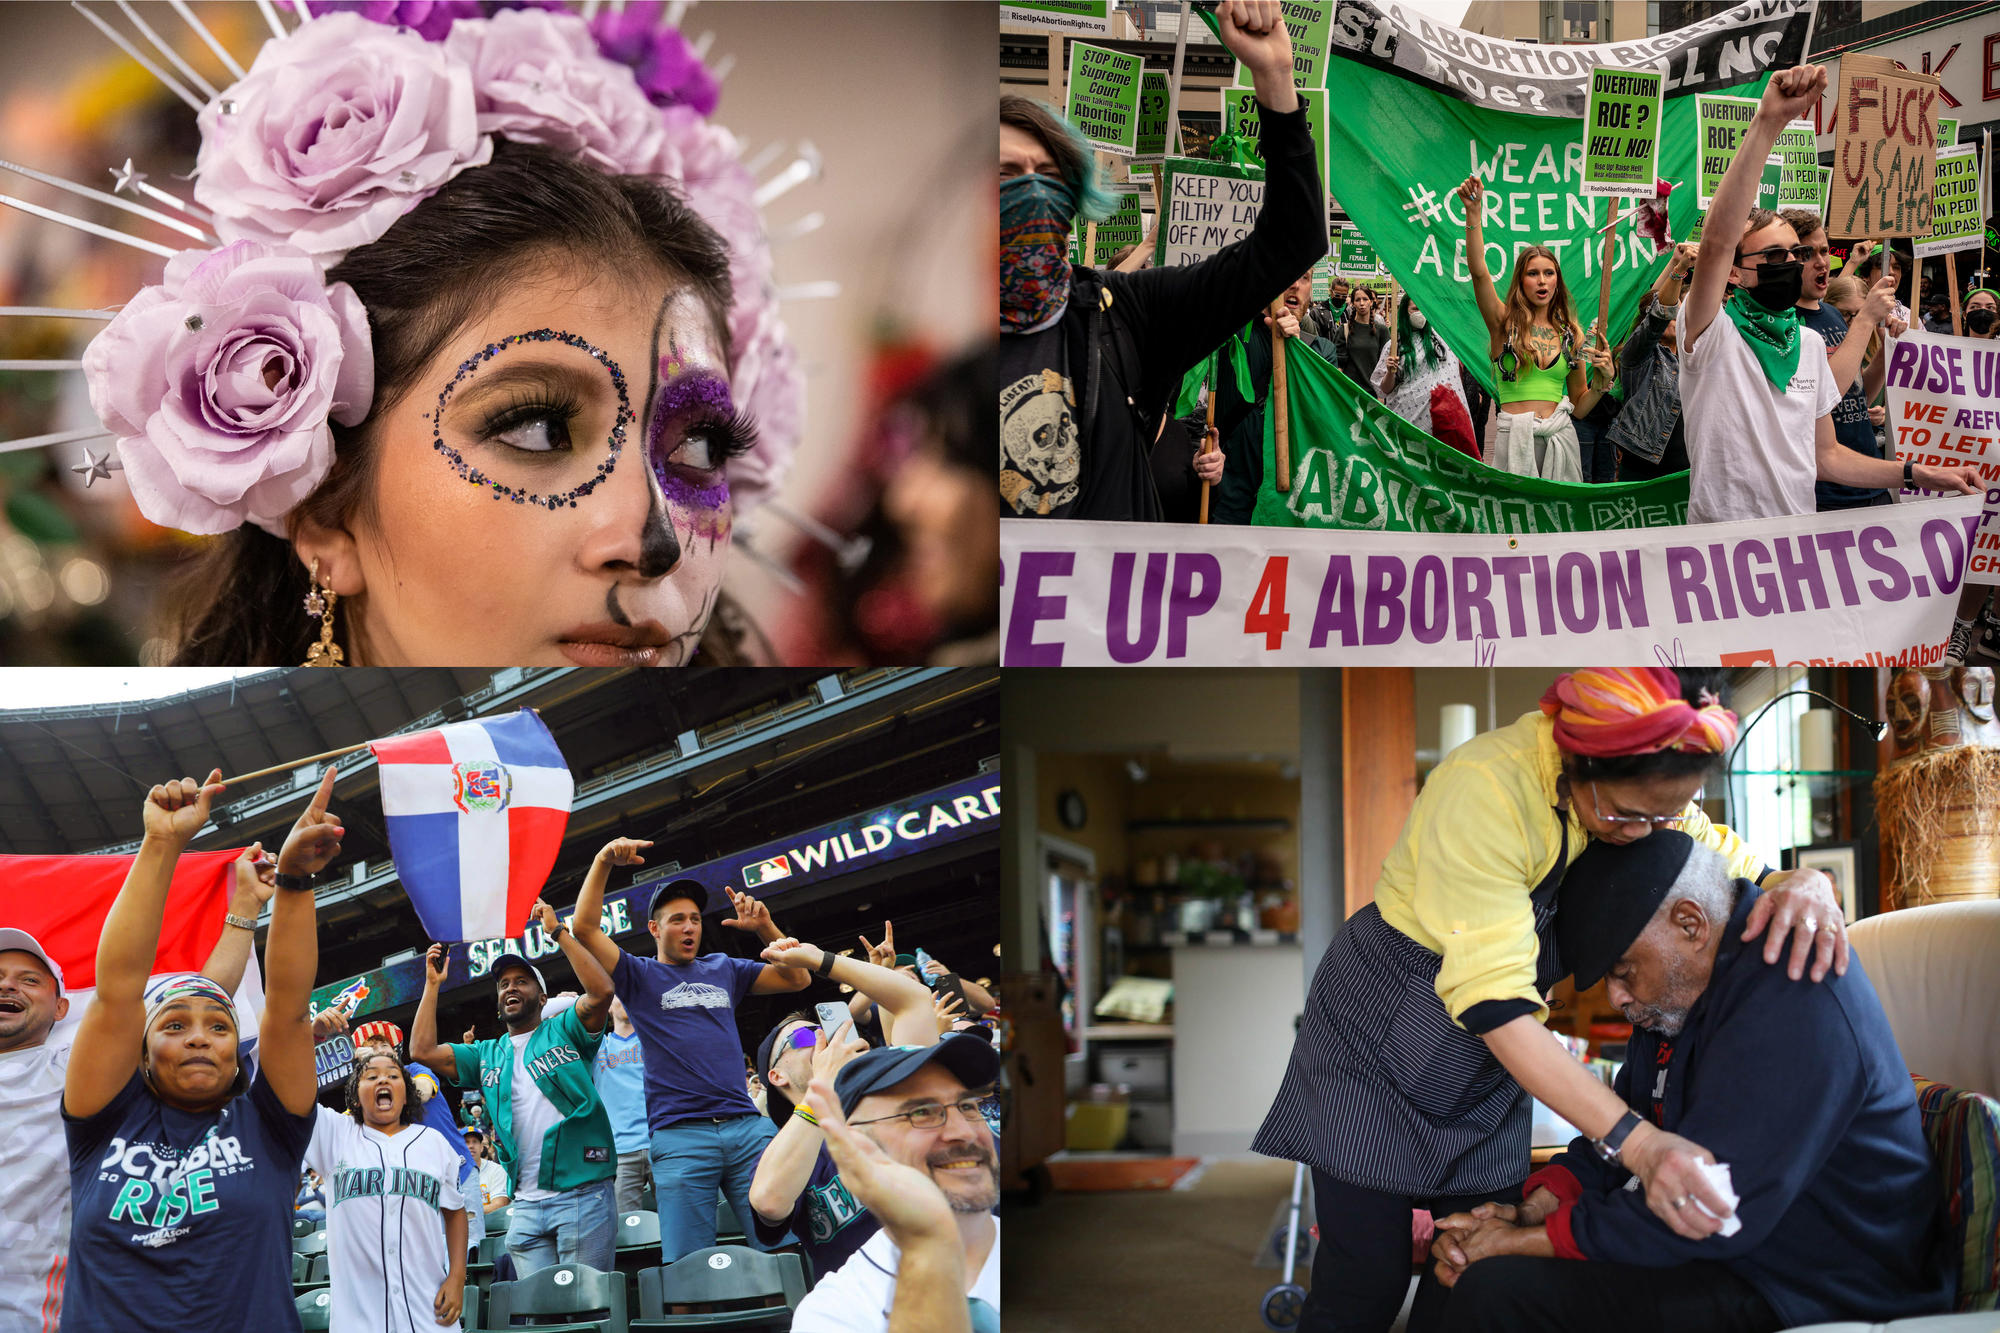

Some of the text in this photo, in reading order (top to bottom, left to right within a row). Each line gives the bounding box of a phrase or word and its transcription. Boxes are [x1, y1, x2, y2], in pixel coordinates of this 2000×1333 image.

[1011, 12, 1106, 32] RiseUp4AbortionRights.org
[1420, 18, 1603, 76] ABORTION
[1083, 49, 1131, 71] STOP the
[1080, 65, 1131, 87] Supreme
[1594, 74, 1658, 98] OVERTURN
[1089, 82, 1120, 99] Court
[1074, 92, 1132, 113] from taking away
[1702, 102, 1756, 122] OVERTURN
[1848, 77, 1934, 150] FUCK
[1074, 103, 1126, 126] Abortion
[1597, 101, 1650, 130] ROE ?
[1080, 120, 1122, 141] Rights!
[1708, 126, 1736, 150] ROE
[1589, 136, 1653, 159] HELL NO!
[1469, 139, 1582, 184] WEAR
[1594, 163, 1606, 171] Rise
[1843, 138, 1924, 194] U SAM
[1967, 159, 1976, 173] A
[1174, 175, 1219, 199] KEEP
[1590, 185, 1653, 196] RiseUp4AbortionRights.org
[1171, 201, 1223, 223] FILTHY
[1402, 182, 1596, 232] #GREEN
[1950, 197, 1978, 216] PEDI
[1169, 225, 1199, 245] OFF
[1203, 226, 1228, 247] MY
[1887, 341, 1966, 396] RISE
[1000, 378, 1036, 408] LIBERTY
[1903, 401, 1948, 425] WE
[1898, 426, 1993, 456] TO LET
[1287, 447, 1577, 533] ABORTION
[1106, 552, 1222, 664] UP
[1243, 556, 1290, 651] 4
[1309, 548, 1650, 649] ABORTION
[788, 785, 1000, 873] WILD CARD
[98, 1171, 119, 1183] 20
[108, 1168, 220, 1228] RISE
[716, 1257, 724, 1266] 9
[561, 1273, 567, 1282] 8
